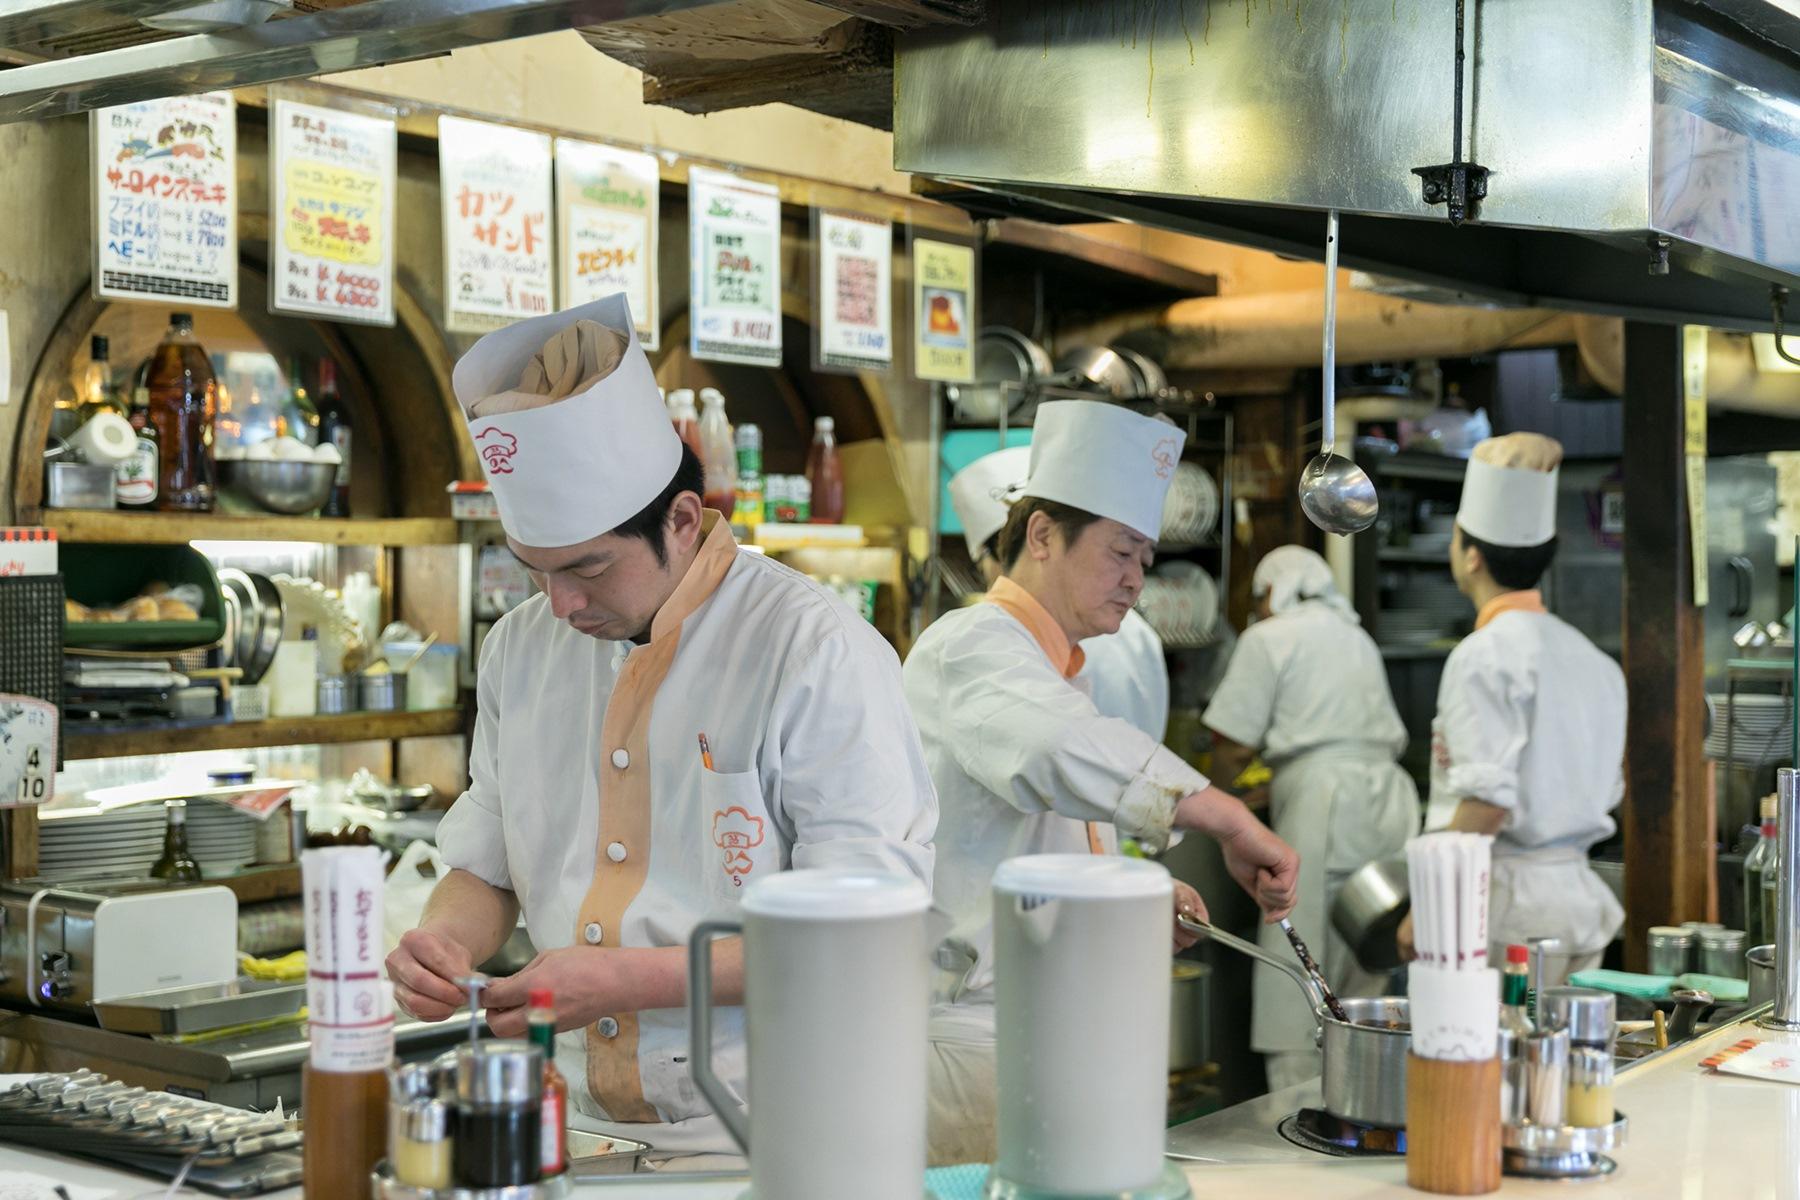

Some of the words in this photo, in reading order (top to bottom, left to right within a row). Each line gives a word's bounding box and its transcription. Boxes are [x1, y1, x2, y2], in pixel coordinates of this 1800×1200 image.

[107, 166, 226, 204] サーロインステーキ
[456, 184, 514, 218] カツ
[473, 212, 545, 255] サンド
[28, 749, 39, 768] 4
[23, 778, 44, 797] 10
[733, 875, 742, 886] 5
